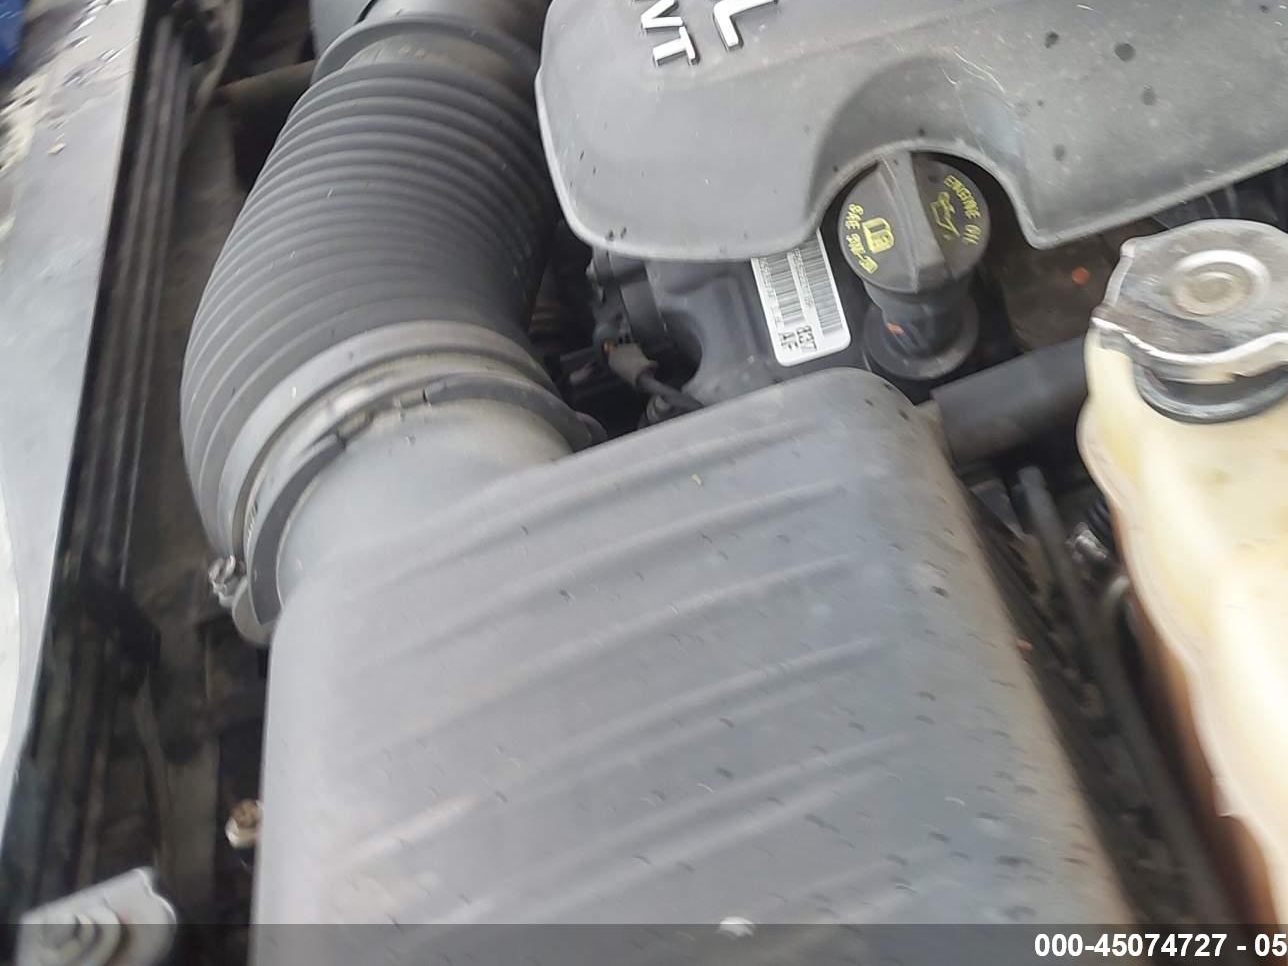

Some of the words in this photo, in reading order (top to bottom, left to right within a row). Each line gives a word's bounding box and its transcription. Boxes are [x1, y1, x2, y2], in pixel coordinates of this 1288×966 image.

[845, 203, 864, 229] SAE
[943, 174, 981, 219] ENGINE
[962, 224, 982, 245] OIL
